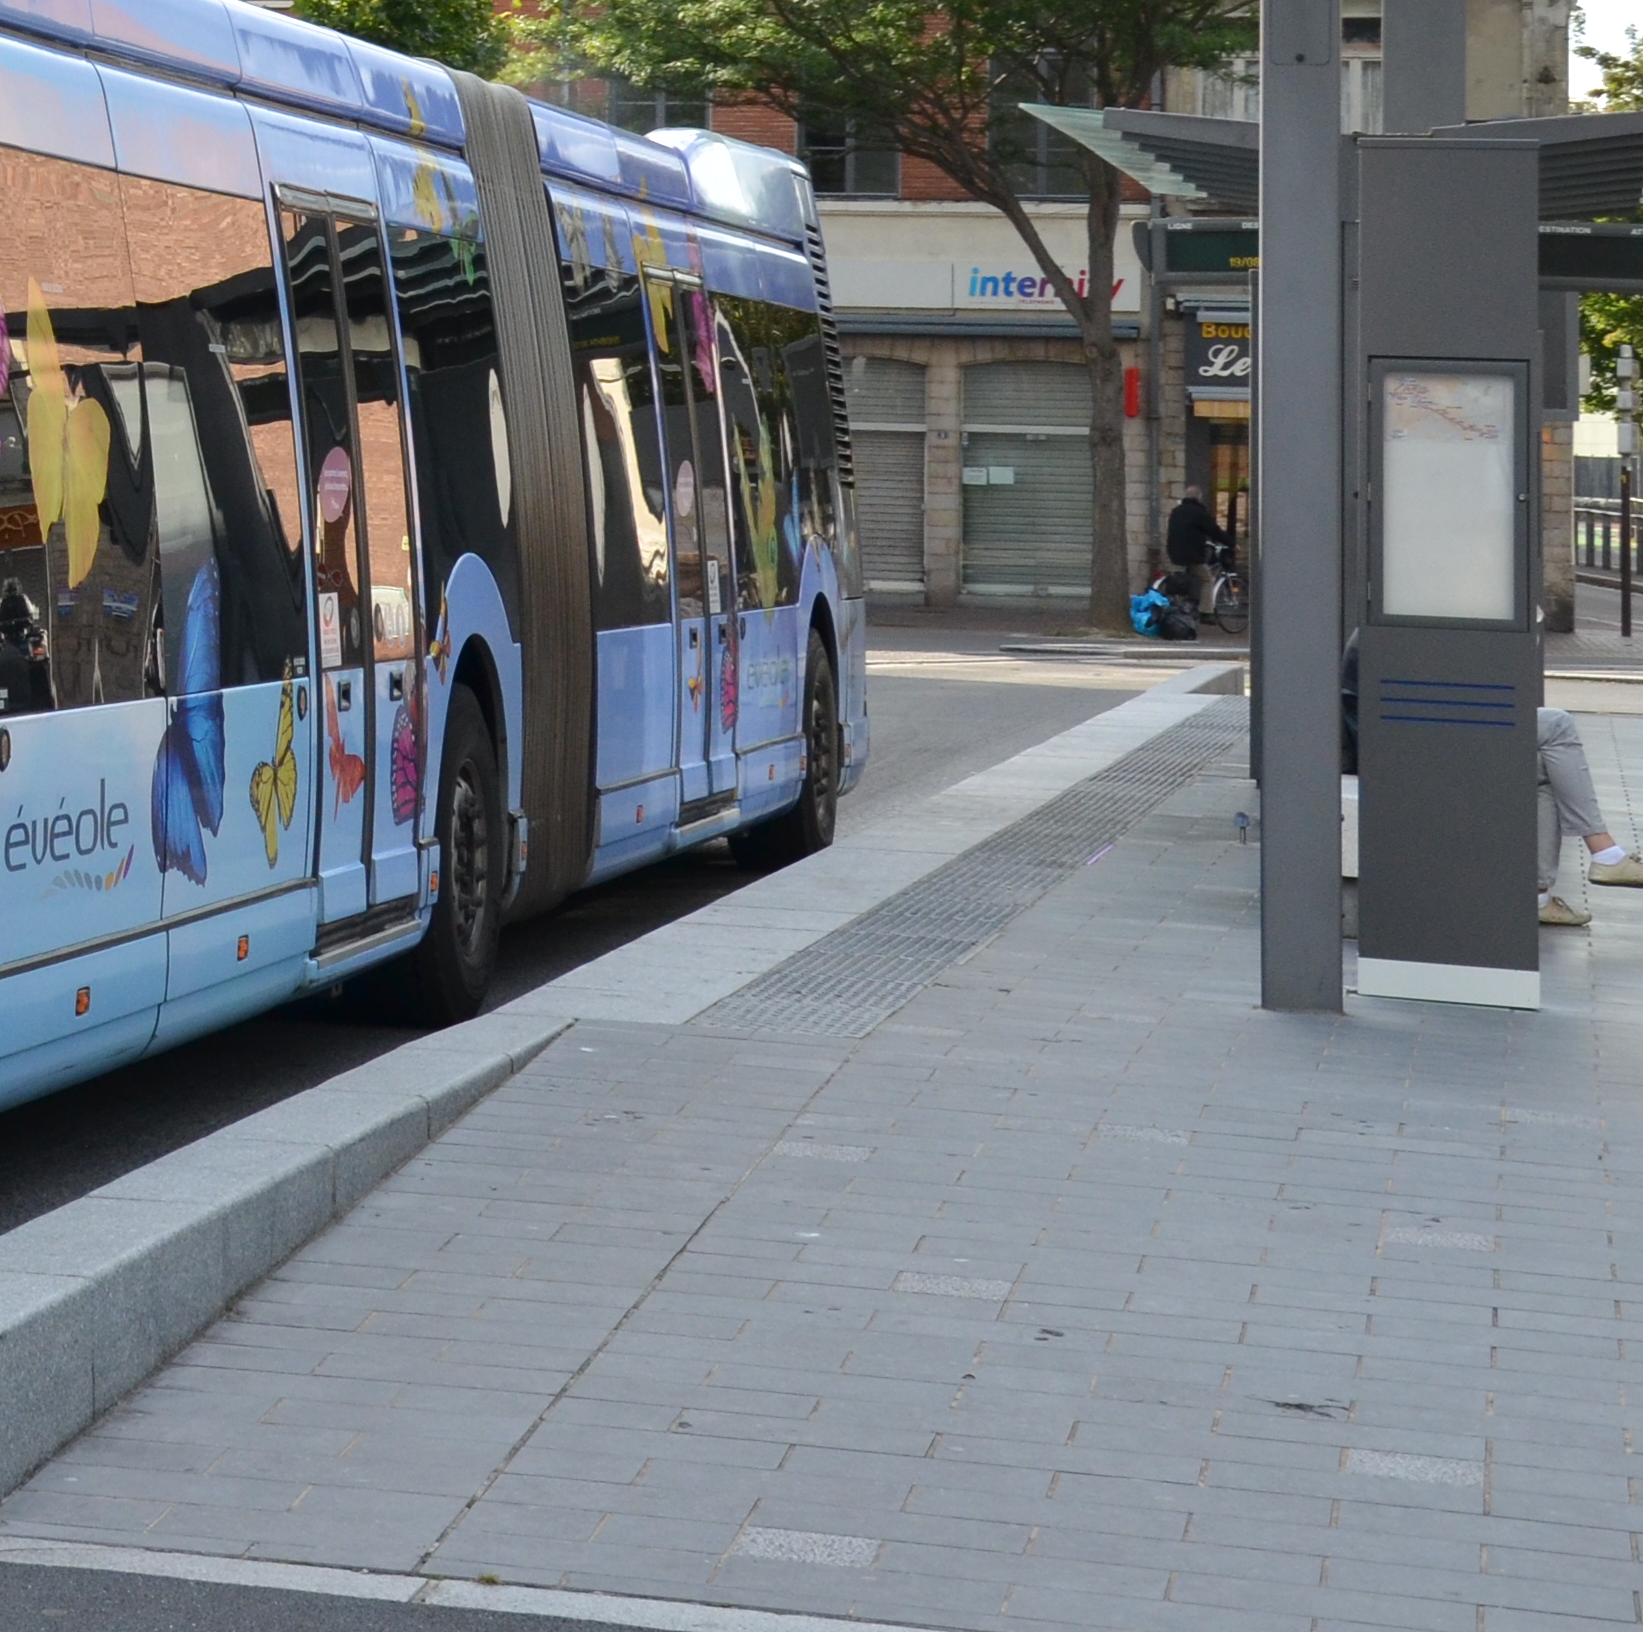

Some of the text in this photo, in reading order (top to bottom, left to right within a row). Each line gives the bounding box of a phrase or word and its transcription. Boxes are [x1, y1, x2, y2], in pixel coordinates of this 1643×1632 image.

[1167, 222, 1193, 230] LIGNE
[1538, 225, 1592, 235] ESTINATION
[4, 777, 130, 872] évéole
